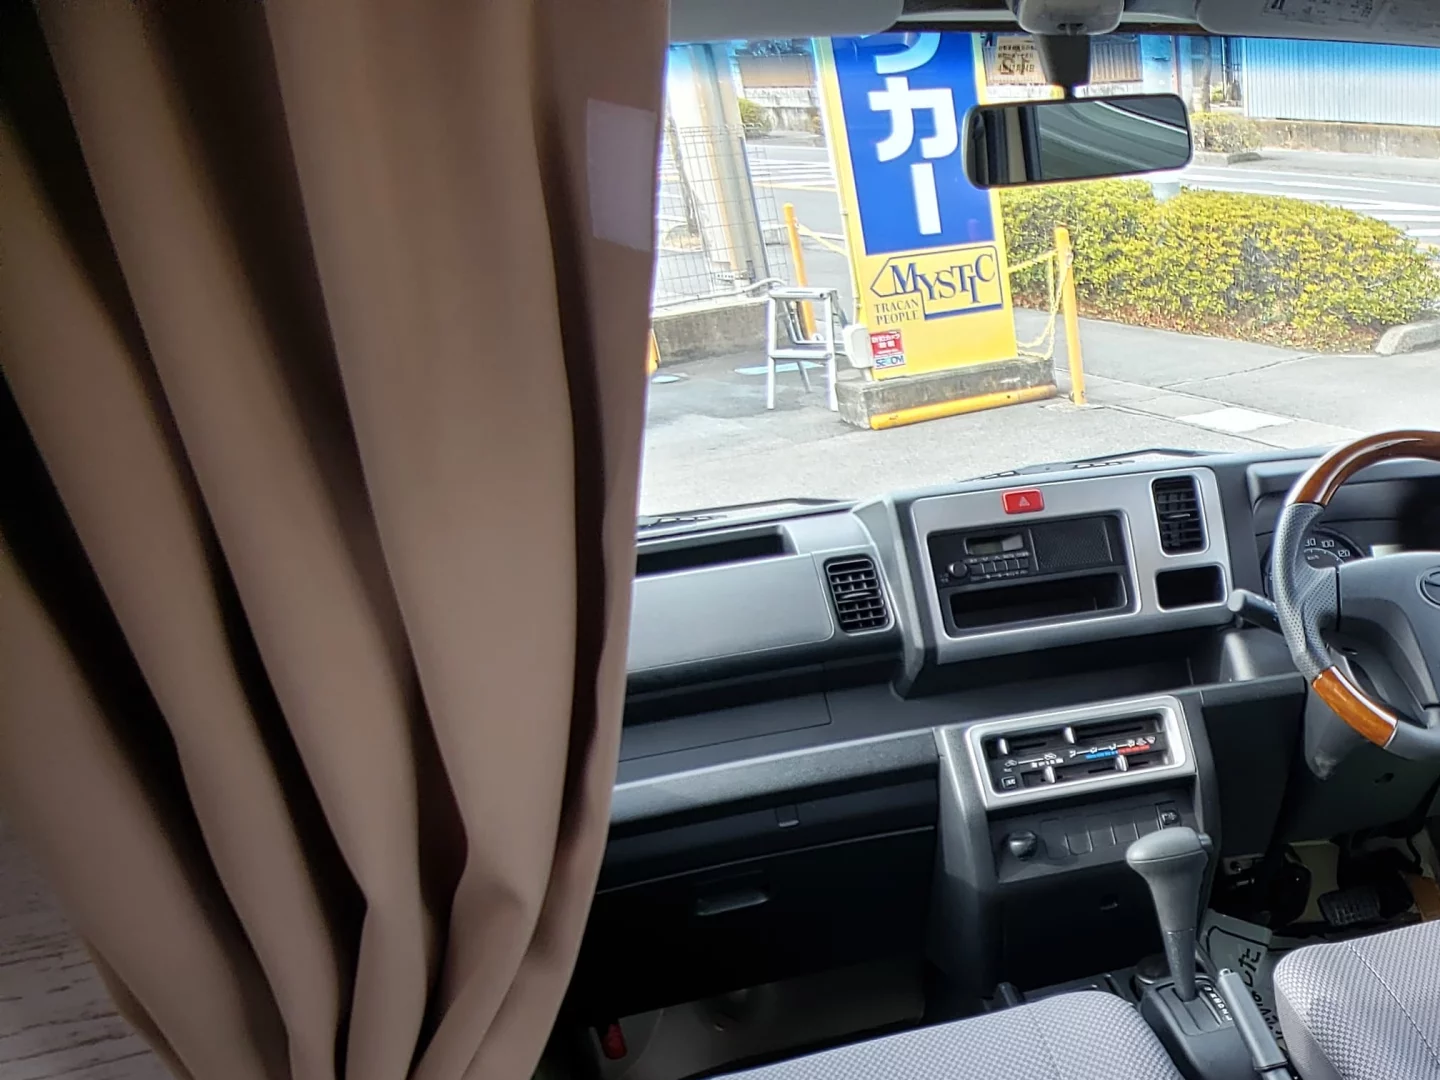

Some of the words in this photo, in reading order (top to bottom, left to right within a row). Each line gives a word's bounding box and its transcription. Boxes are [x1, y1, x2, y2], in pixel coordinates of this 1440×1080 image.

[890, 253, 996, 304] MYSTIC
[874, 298, 919, 314] TRACAN
[876, 310, 920, 326] PEOPLE
